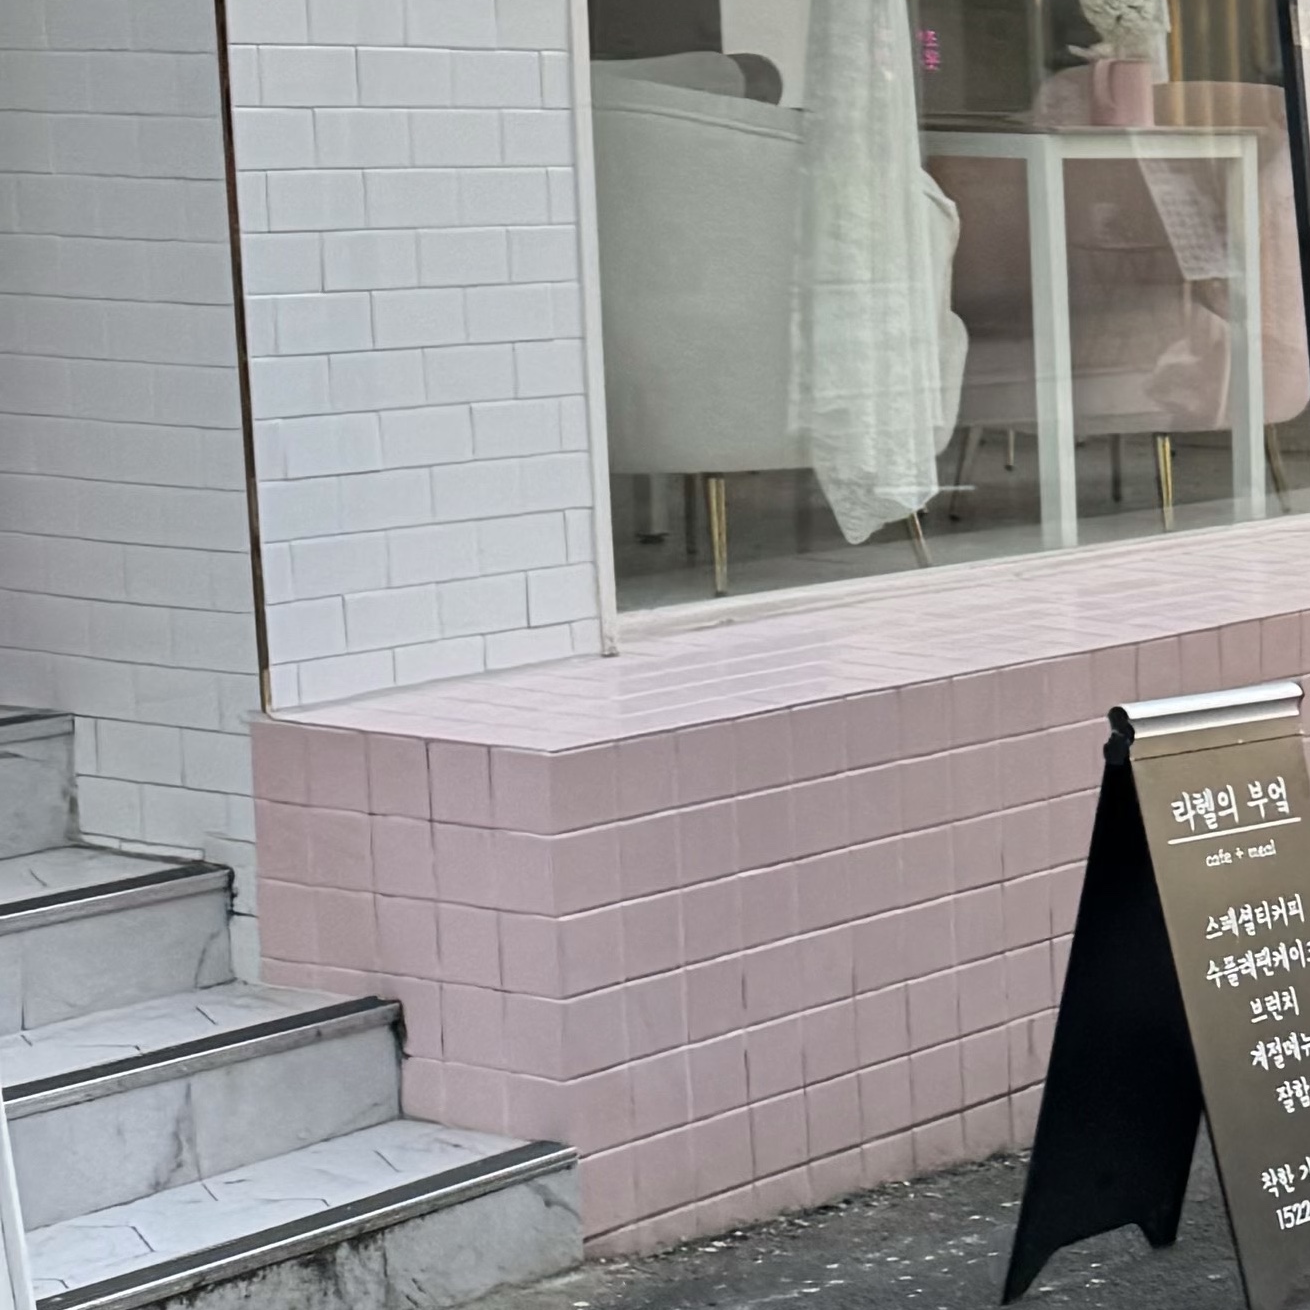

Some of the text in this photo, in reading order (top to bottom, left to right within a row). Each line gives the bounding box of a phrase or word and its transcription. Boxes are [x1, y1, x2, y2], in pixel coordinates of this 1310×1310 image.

[1170, 775, 1291, 833] 라헬의 부엌
[1205, 848, 1233, 867] cafe
[1247, 838, 1277, 859] meal
[1205, 893, 1305, 940] 스페셜티커피
[1250, 986, 1300, 1024] 브런치
[1276, 1076, 1310, 1114] 잘함
[1261, 1163, 1296, 1198] 착한
